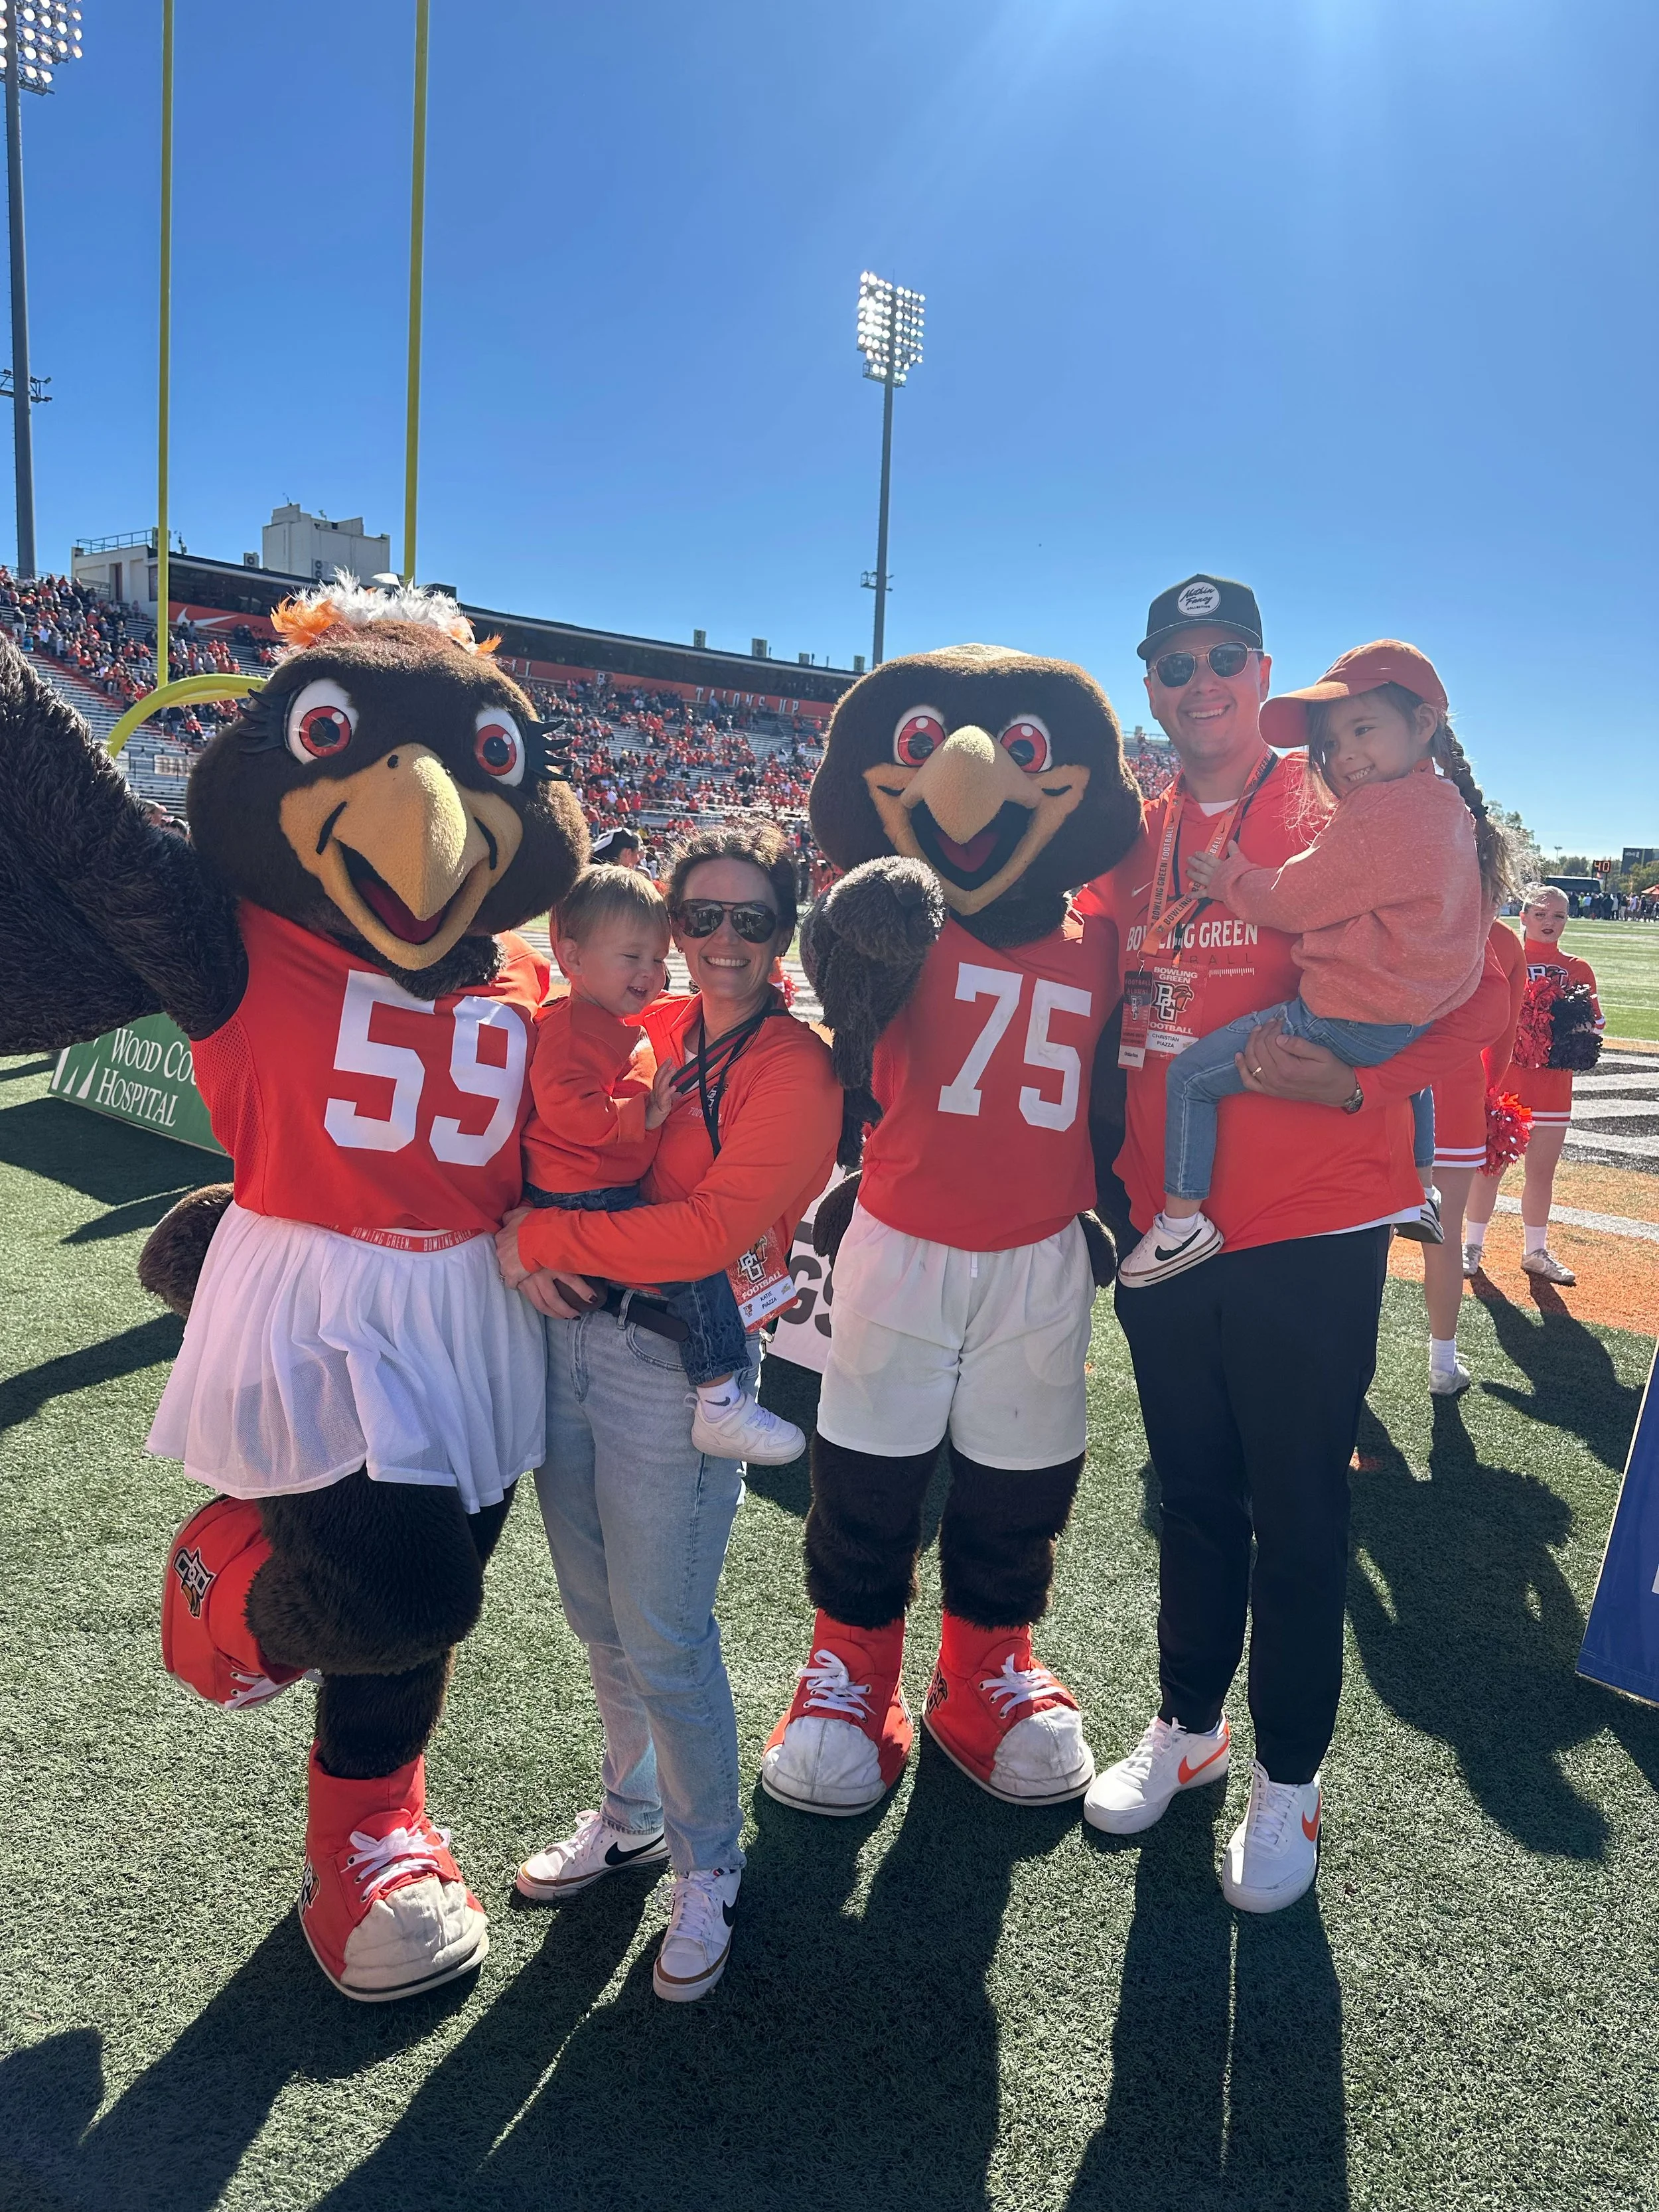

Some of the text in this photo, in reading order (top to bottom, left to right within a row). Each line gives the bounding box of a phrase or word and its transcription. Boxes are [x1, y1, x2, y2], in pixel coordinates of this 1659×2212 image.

[1185, 596, 1213, 606] Fancy
[779, 699, 799, 714] UP
[1151, 825, 1175, 921] BOWLING GREEN FOOTBALL
[1594, 861, 1610, 873] 40
[1163, 897, 1192, 925] BOWLING
[1125, 919, 1258, 952] BOING GREEN
[1153, 966, 1198, 979] BOWLING
[1159, 974, 1191, 984] GREEN
[1149, 1022, 1193, 1035] OOTBALL
[1151, 1033, 1180, 1043] CHRISTIAN
[111, 1027, 163, 1073] WOOD
[937, 962, 1092, 1132] 75
[324, 969, 528, 1167] 59
[95, 1067, 179, 1128] HOSPITAL
[688, 1106, 722, 1123] FOOTL
[350, 1226, 385, 1244] BOWLING
[386, 1234, 409, 1250] GREEN
[423, 1234, 453, 1252] BOWLING
[742, 1270, 783, 1300] FOOTBALL
[760, 1290, 773, 1301] KATIE
[761, 1297, 778, 1309] PIAZZA
